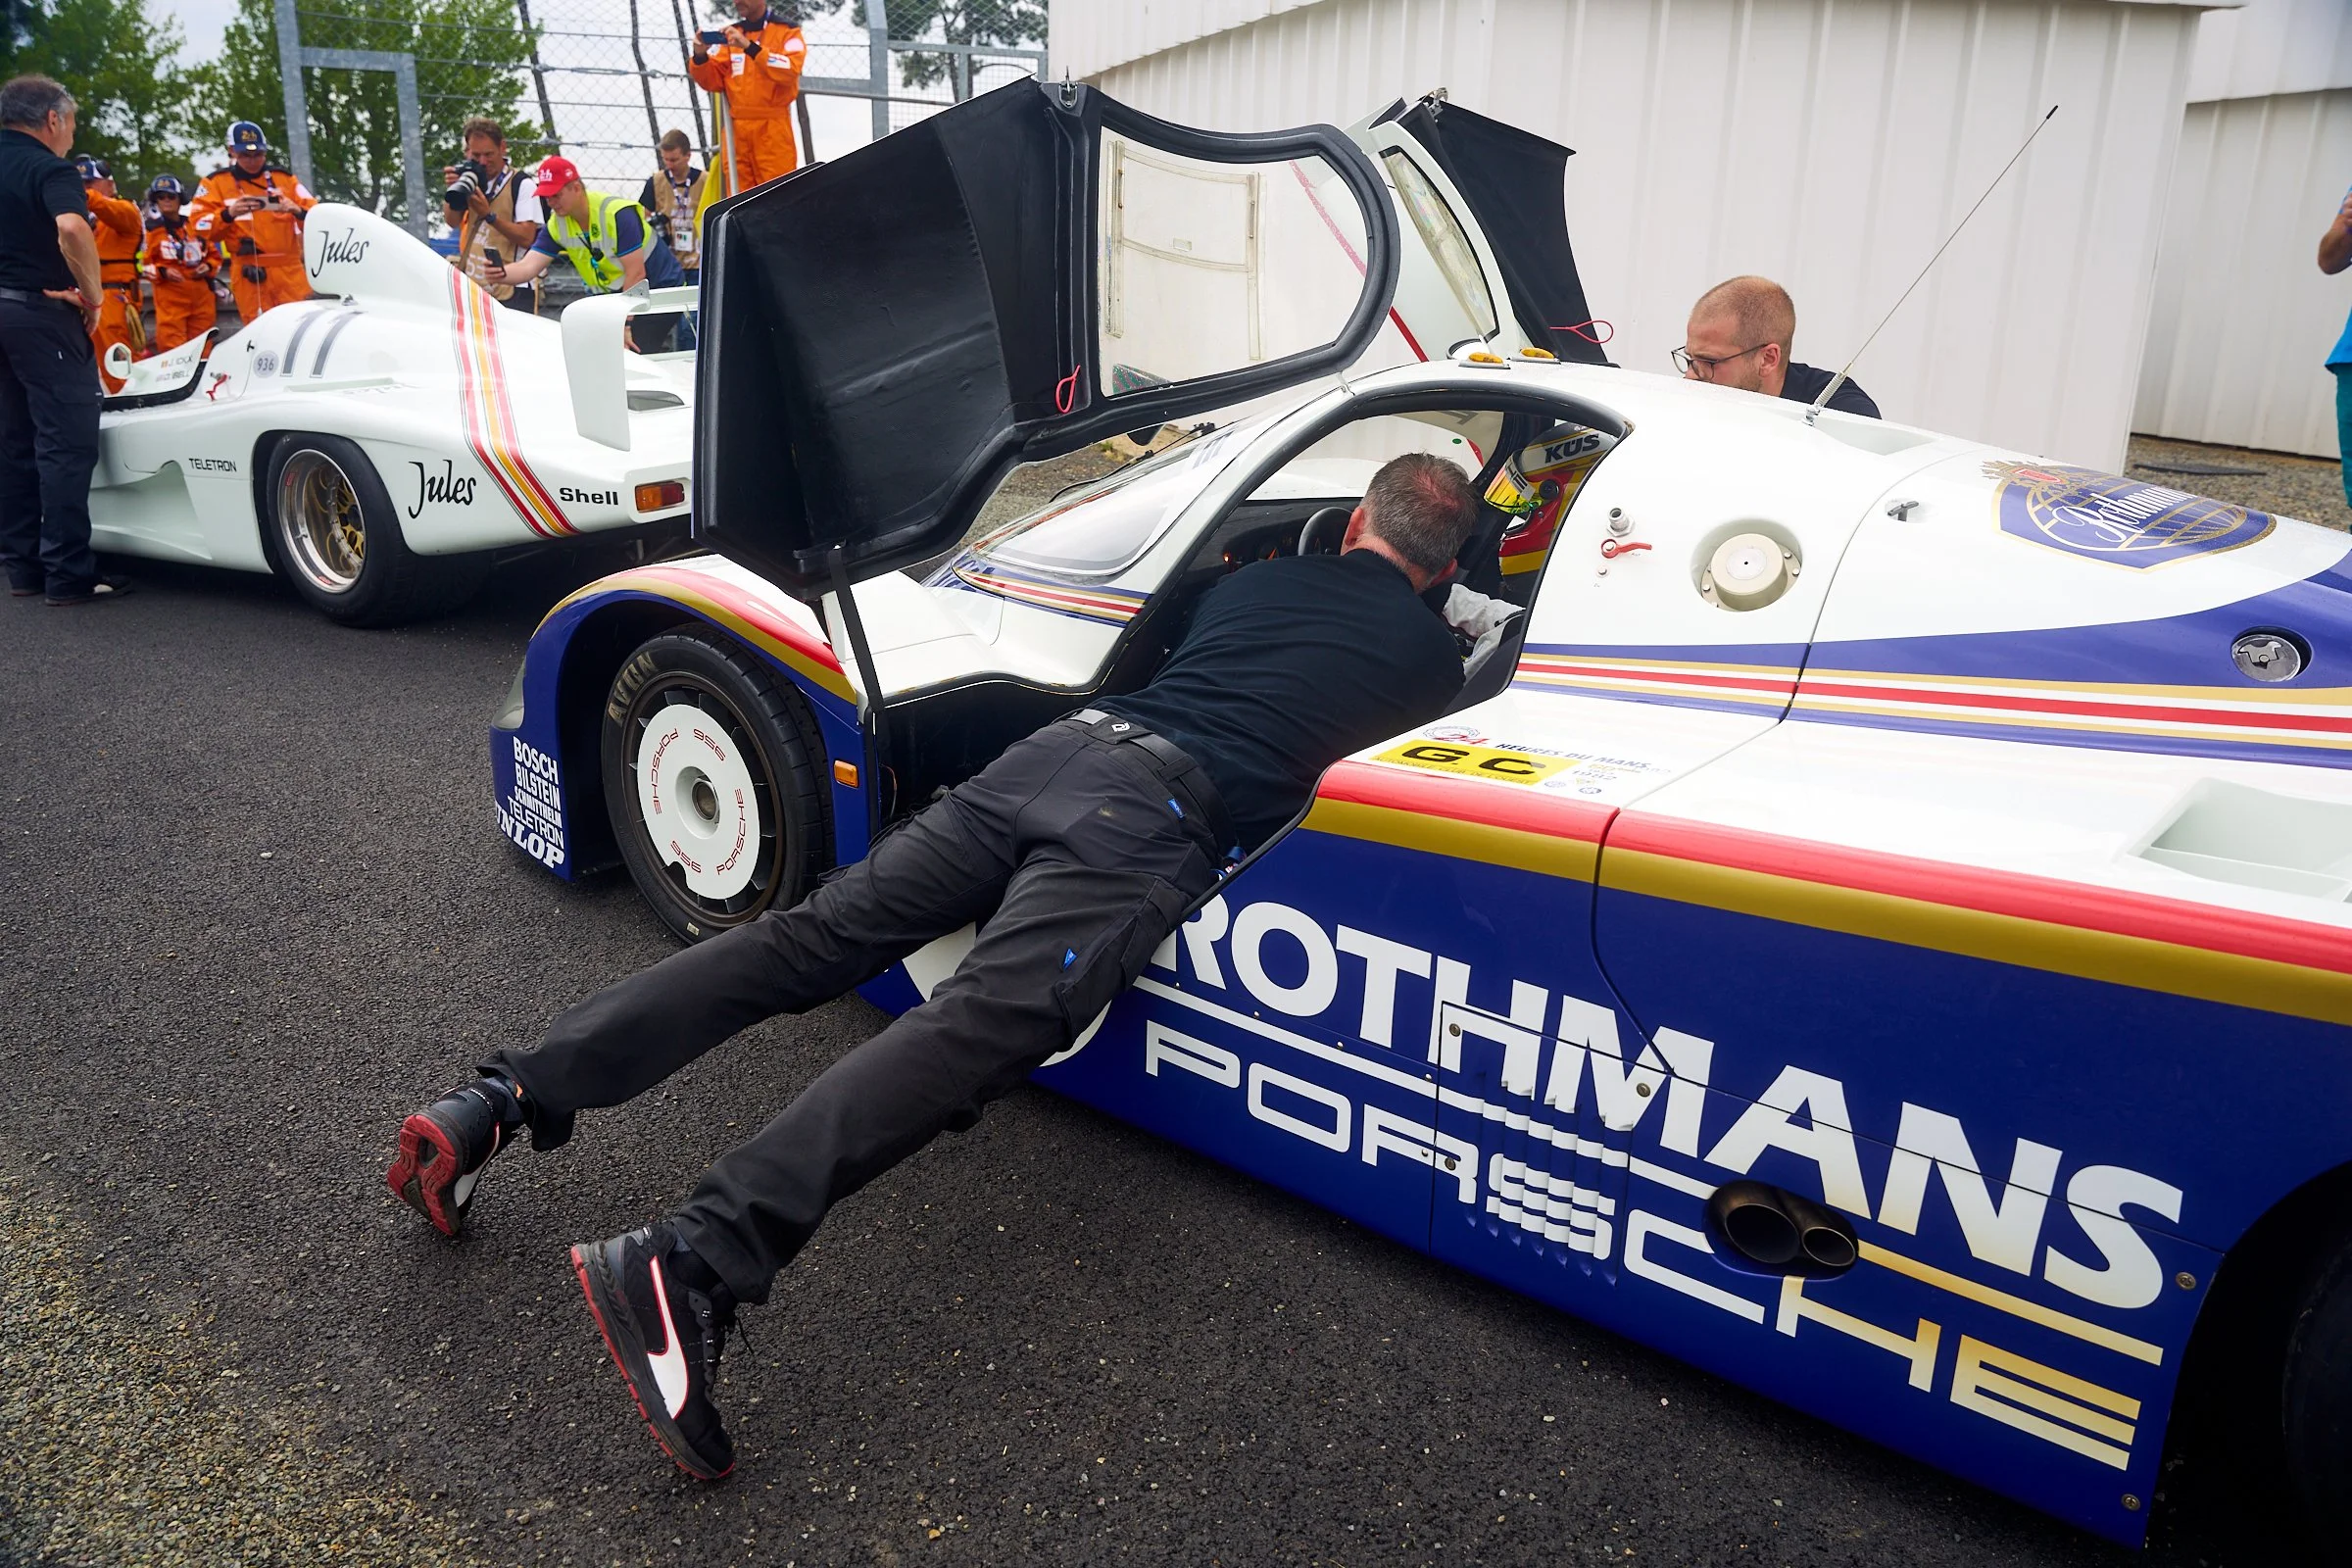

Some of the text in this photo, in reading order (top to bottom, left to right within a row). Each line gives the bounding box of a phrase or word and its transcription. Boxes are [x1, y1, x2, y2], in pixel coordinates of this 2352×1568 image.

[311, 226, 370, 278] Jules
[257, 358, 274, 371] 936
[189, 457, 237, 473] TELETRON
[1544, 433, 1600, 464] KÜS
[408, 459, 476, 518] Jules
[560, 486, 619, 506] Shell
[513, 735, 559, 785] BOSCH
[693, 728, 726, 761] 956
[1593, 757, 1652, 768] MANS
[514, 761, 562, 811] BILSTEIN
[651, 728, 679, 815] PORSCHE
[495, 800, 565, 868] UNLOP
[507, 795, 564, 850] TELETRON
[716, 789, 747, 875] PORSCHE
[670, 840, 702, 874] 956
[1152, 892, 2183, 1308] ROTHMANS
[1145, 1019, 2142, 1471] PORSCHE
